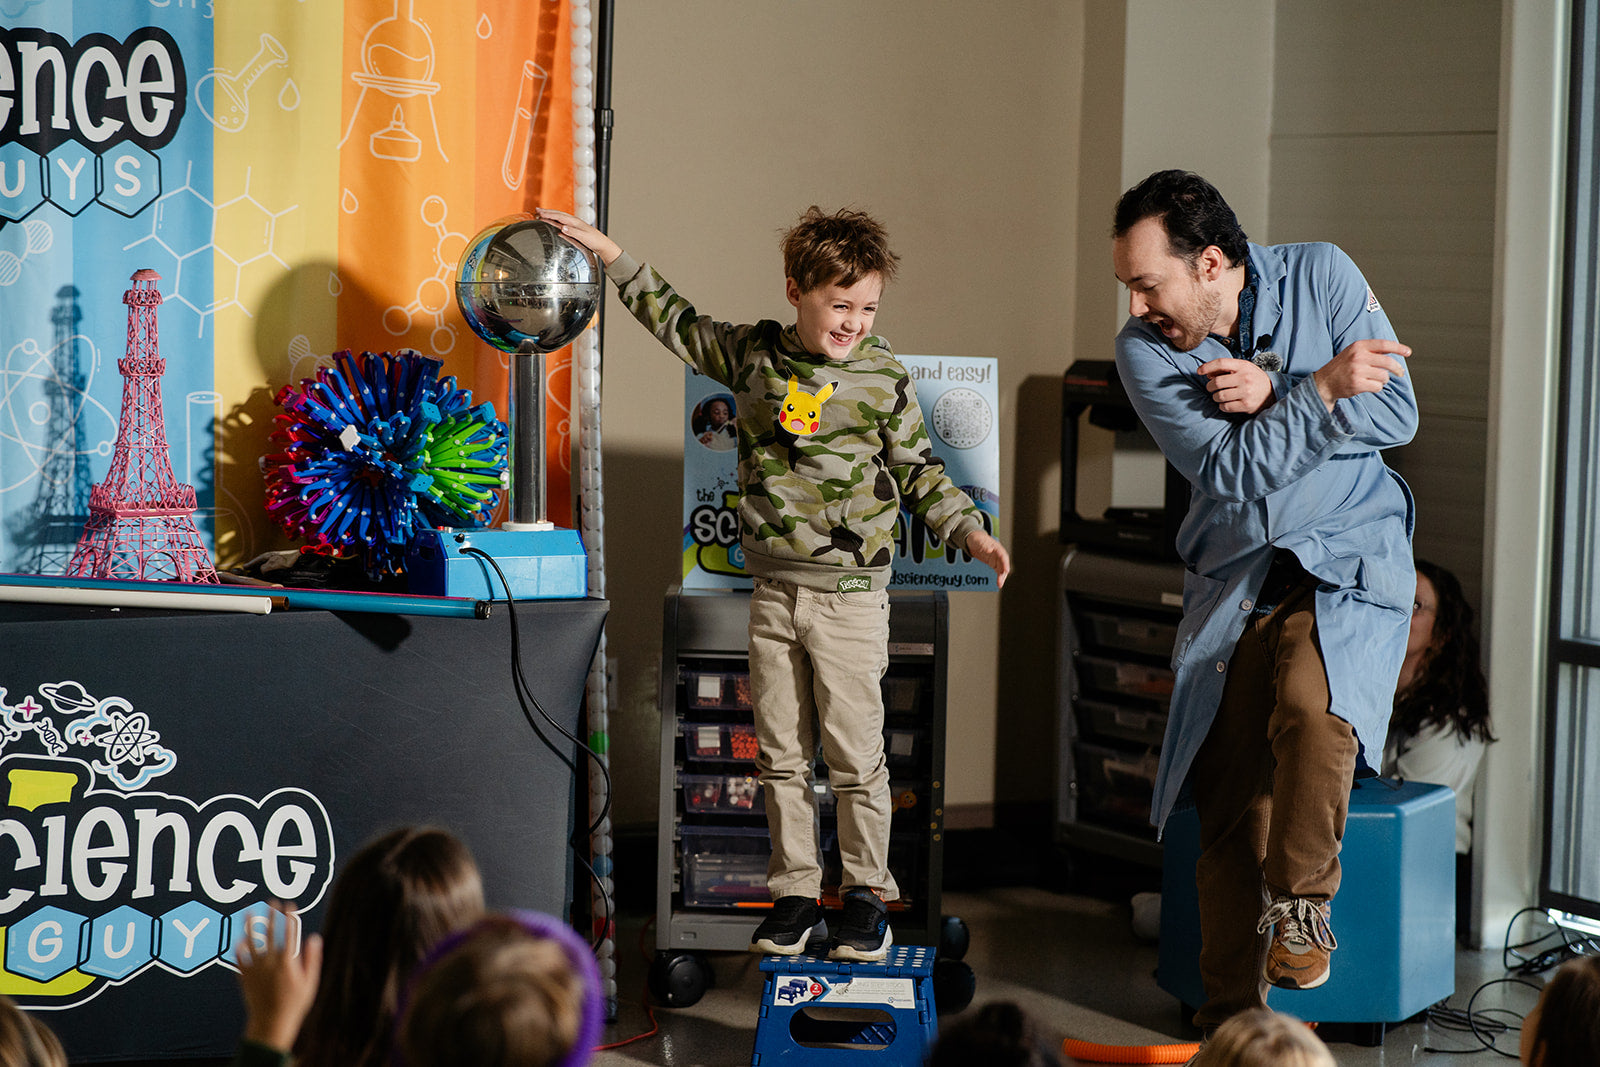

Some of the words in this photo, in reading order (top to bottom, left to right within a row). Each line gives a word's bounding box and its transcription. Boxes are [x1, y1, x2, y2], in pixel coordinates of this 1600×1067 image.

[911, 361, 942, 380] and
[947, 364, 991, 384] easy!
[696, 488, 715, 502] the
